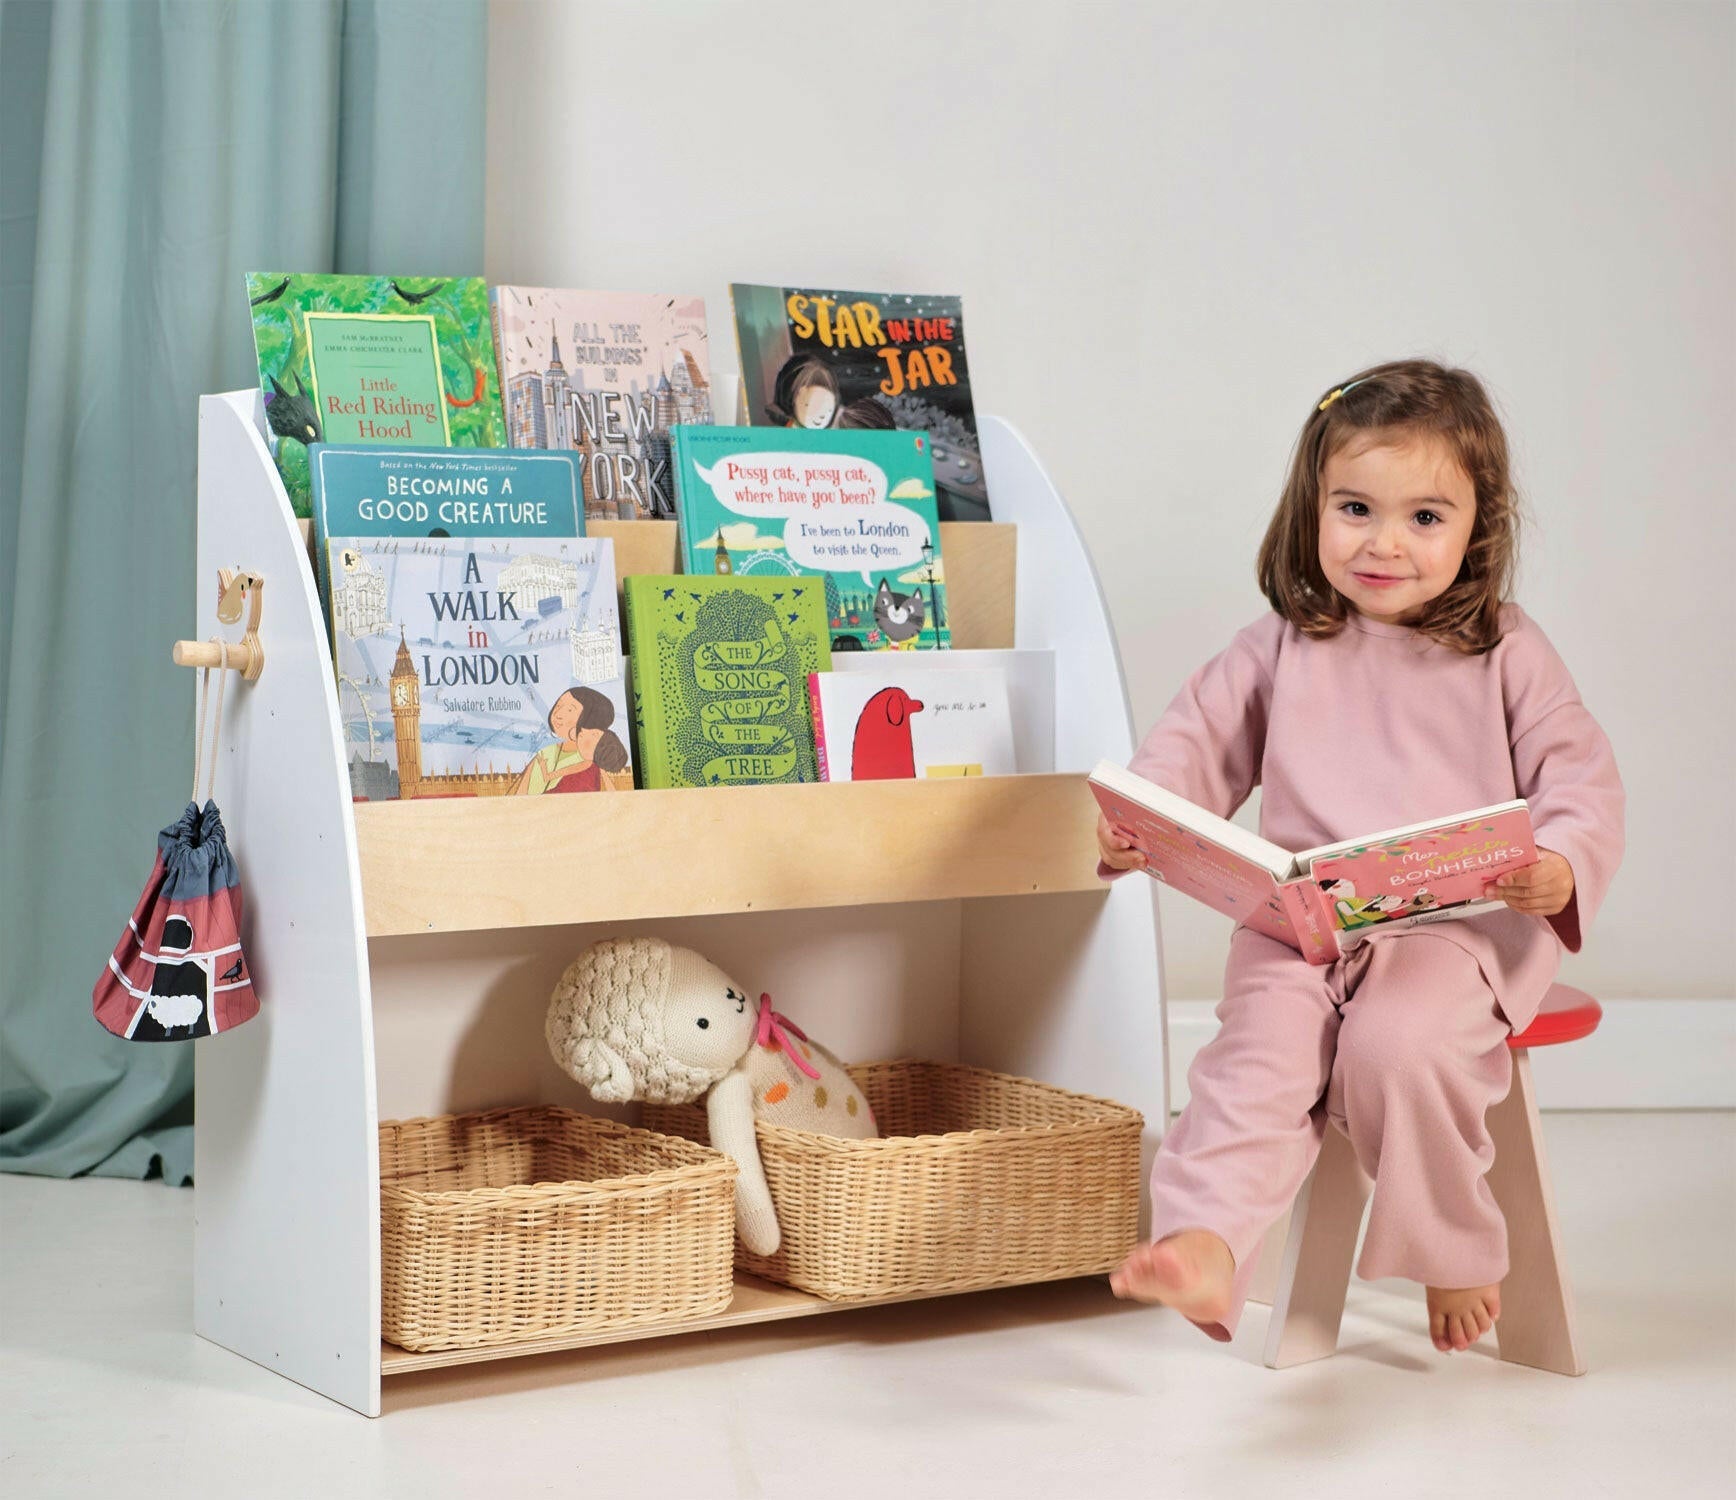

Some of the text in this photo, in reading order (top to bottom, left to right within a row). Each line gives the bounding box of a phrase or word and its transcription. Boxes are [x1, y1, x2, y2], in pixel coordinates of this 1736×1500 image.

[786, 294, 955, 348] STAR IN THE
[876, 345, 958, 397] JAR
[360, 377, 398, 392] Little
[327, 395, 438, 424] Red Riding
[570, 391, 659, 445] NEW
[358, 420, 413, 439] Hood
[380, 460, 401, 469] Based
[415, 462, 427, 470] the
[429, 462, 444, 470] New
[445, 462, 459, 471] York
[461, 463, 482, 471] Times
[727, 462, 872, 488] Pussy cat, pussy cat,
[387, 475, 513, 496] BECOMING A
[734, 486, 876, 509] where have you been?
[358, 498, 548, 525] GOOD CREATURE
[800, 519, 909, 538] I've been to London
[813, 543, 902, 557] to visit the Queen.
[463, 552, 482, 584] A
[426, 590, 522, 621] WALK
[467, 624, 489, 648] in
[726, 647, 754, 660] THE
[422, 654, 540, 686] LONDON
[714, 672, 771, 690] SONG
[443, 697, 522, 713] Salvatore Rubbino
[735, 703, 753, 715] OF
[734, 728, 761, 741] THE
[725, 758, 774, 777] TREE
[1389, 846, 1524, 886] BONHEURS
